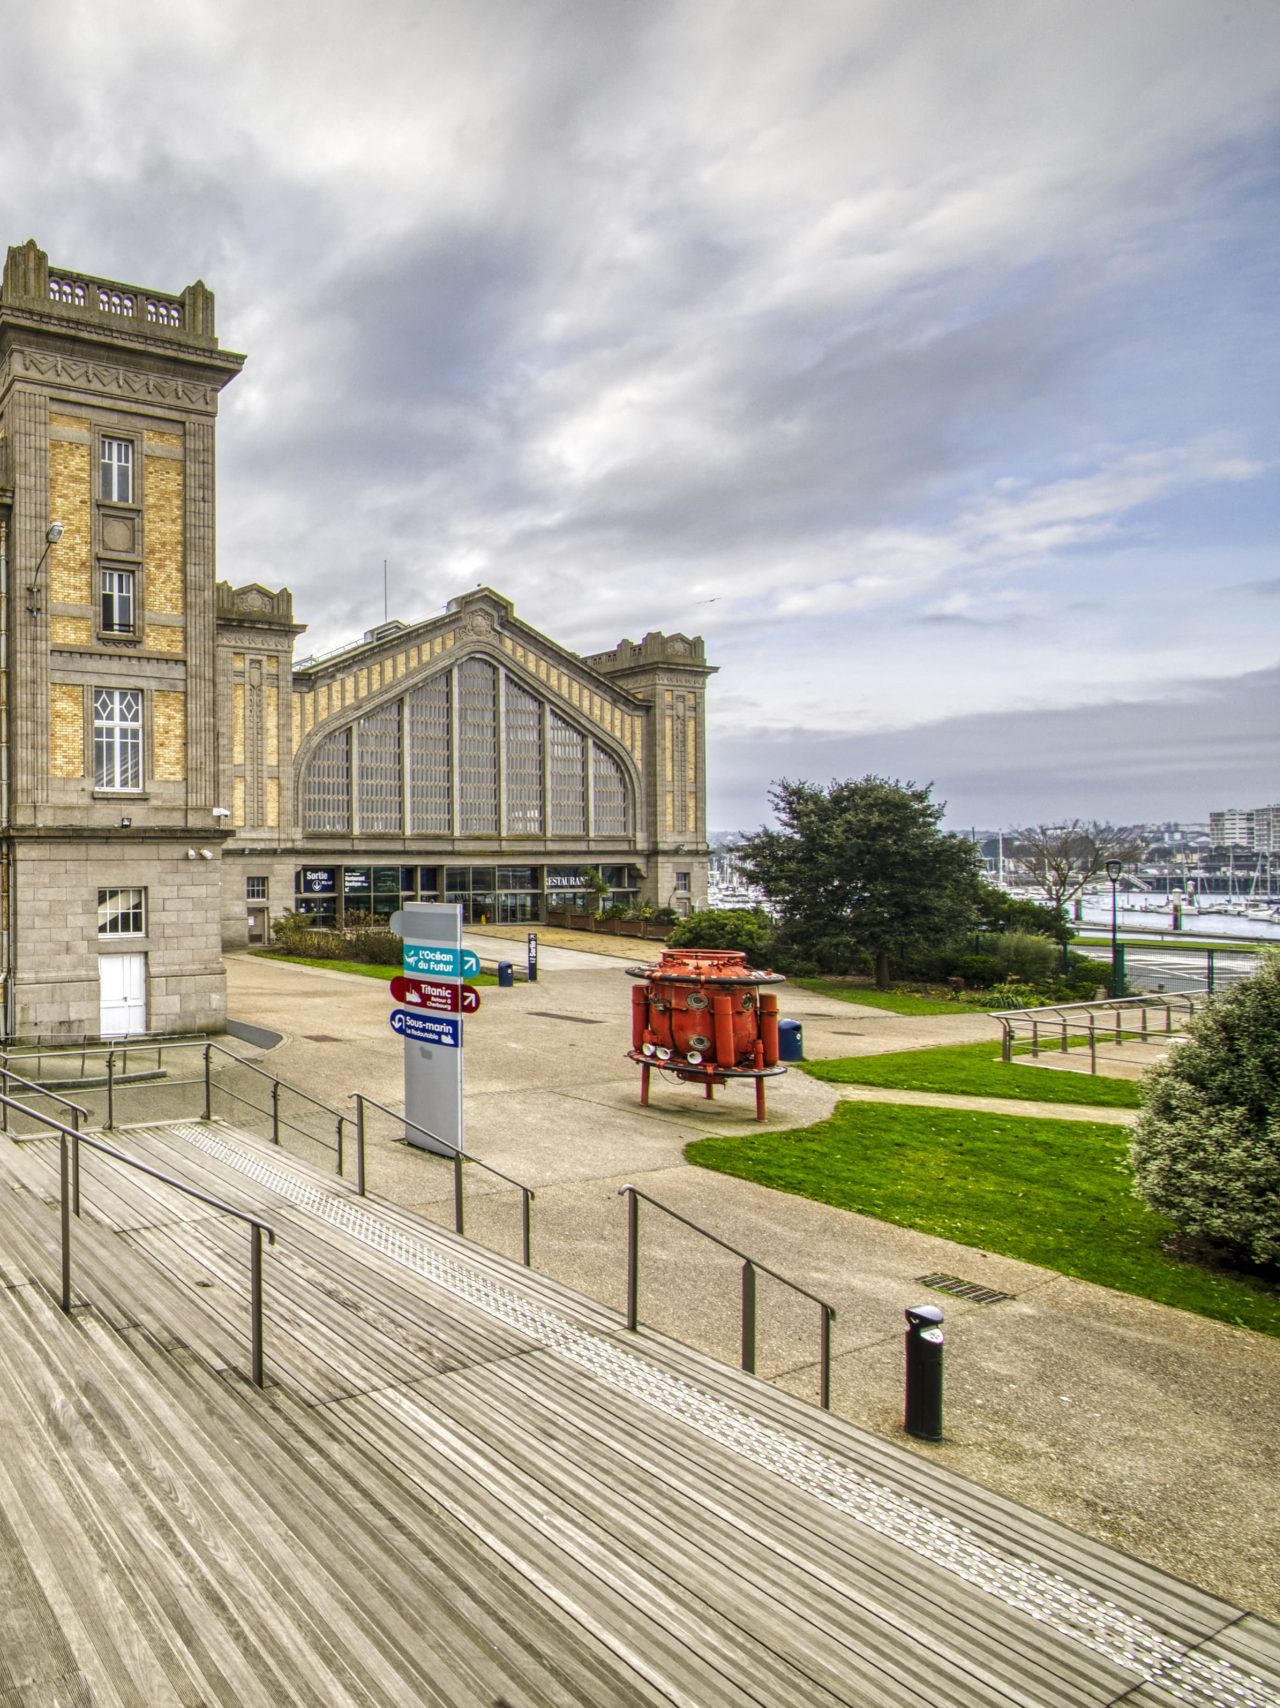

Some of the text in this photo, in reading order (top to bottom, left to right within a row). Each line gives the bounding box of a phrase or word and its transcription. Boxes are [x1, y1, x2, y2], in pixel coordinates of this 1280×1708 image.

[306, 871, 328, 880] Sortie
[419, 950, 453, 961] L'Océan
[418, 960, 453, 972] du Futur
[420, 984, 452, 998] Titanic
[426, 1001, 452, 1010] Cherbourg
[405, 1016, 453, 1034] Sous-marin
[412, 1029, 438, 1040] Redoutable
